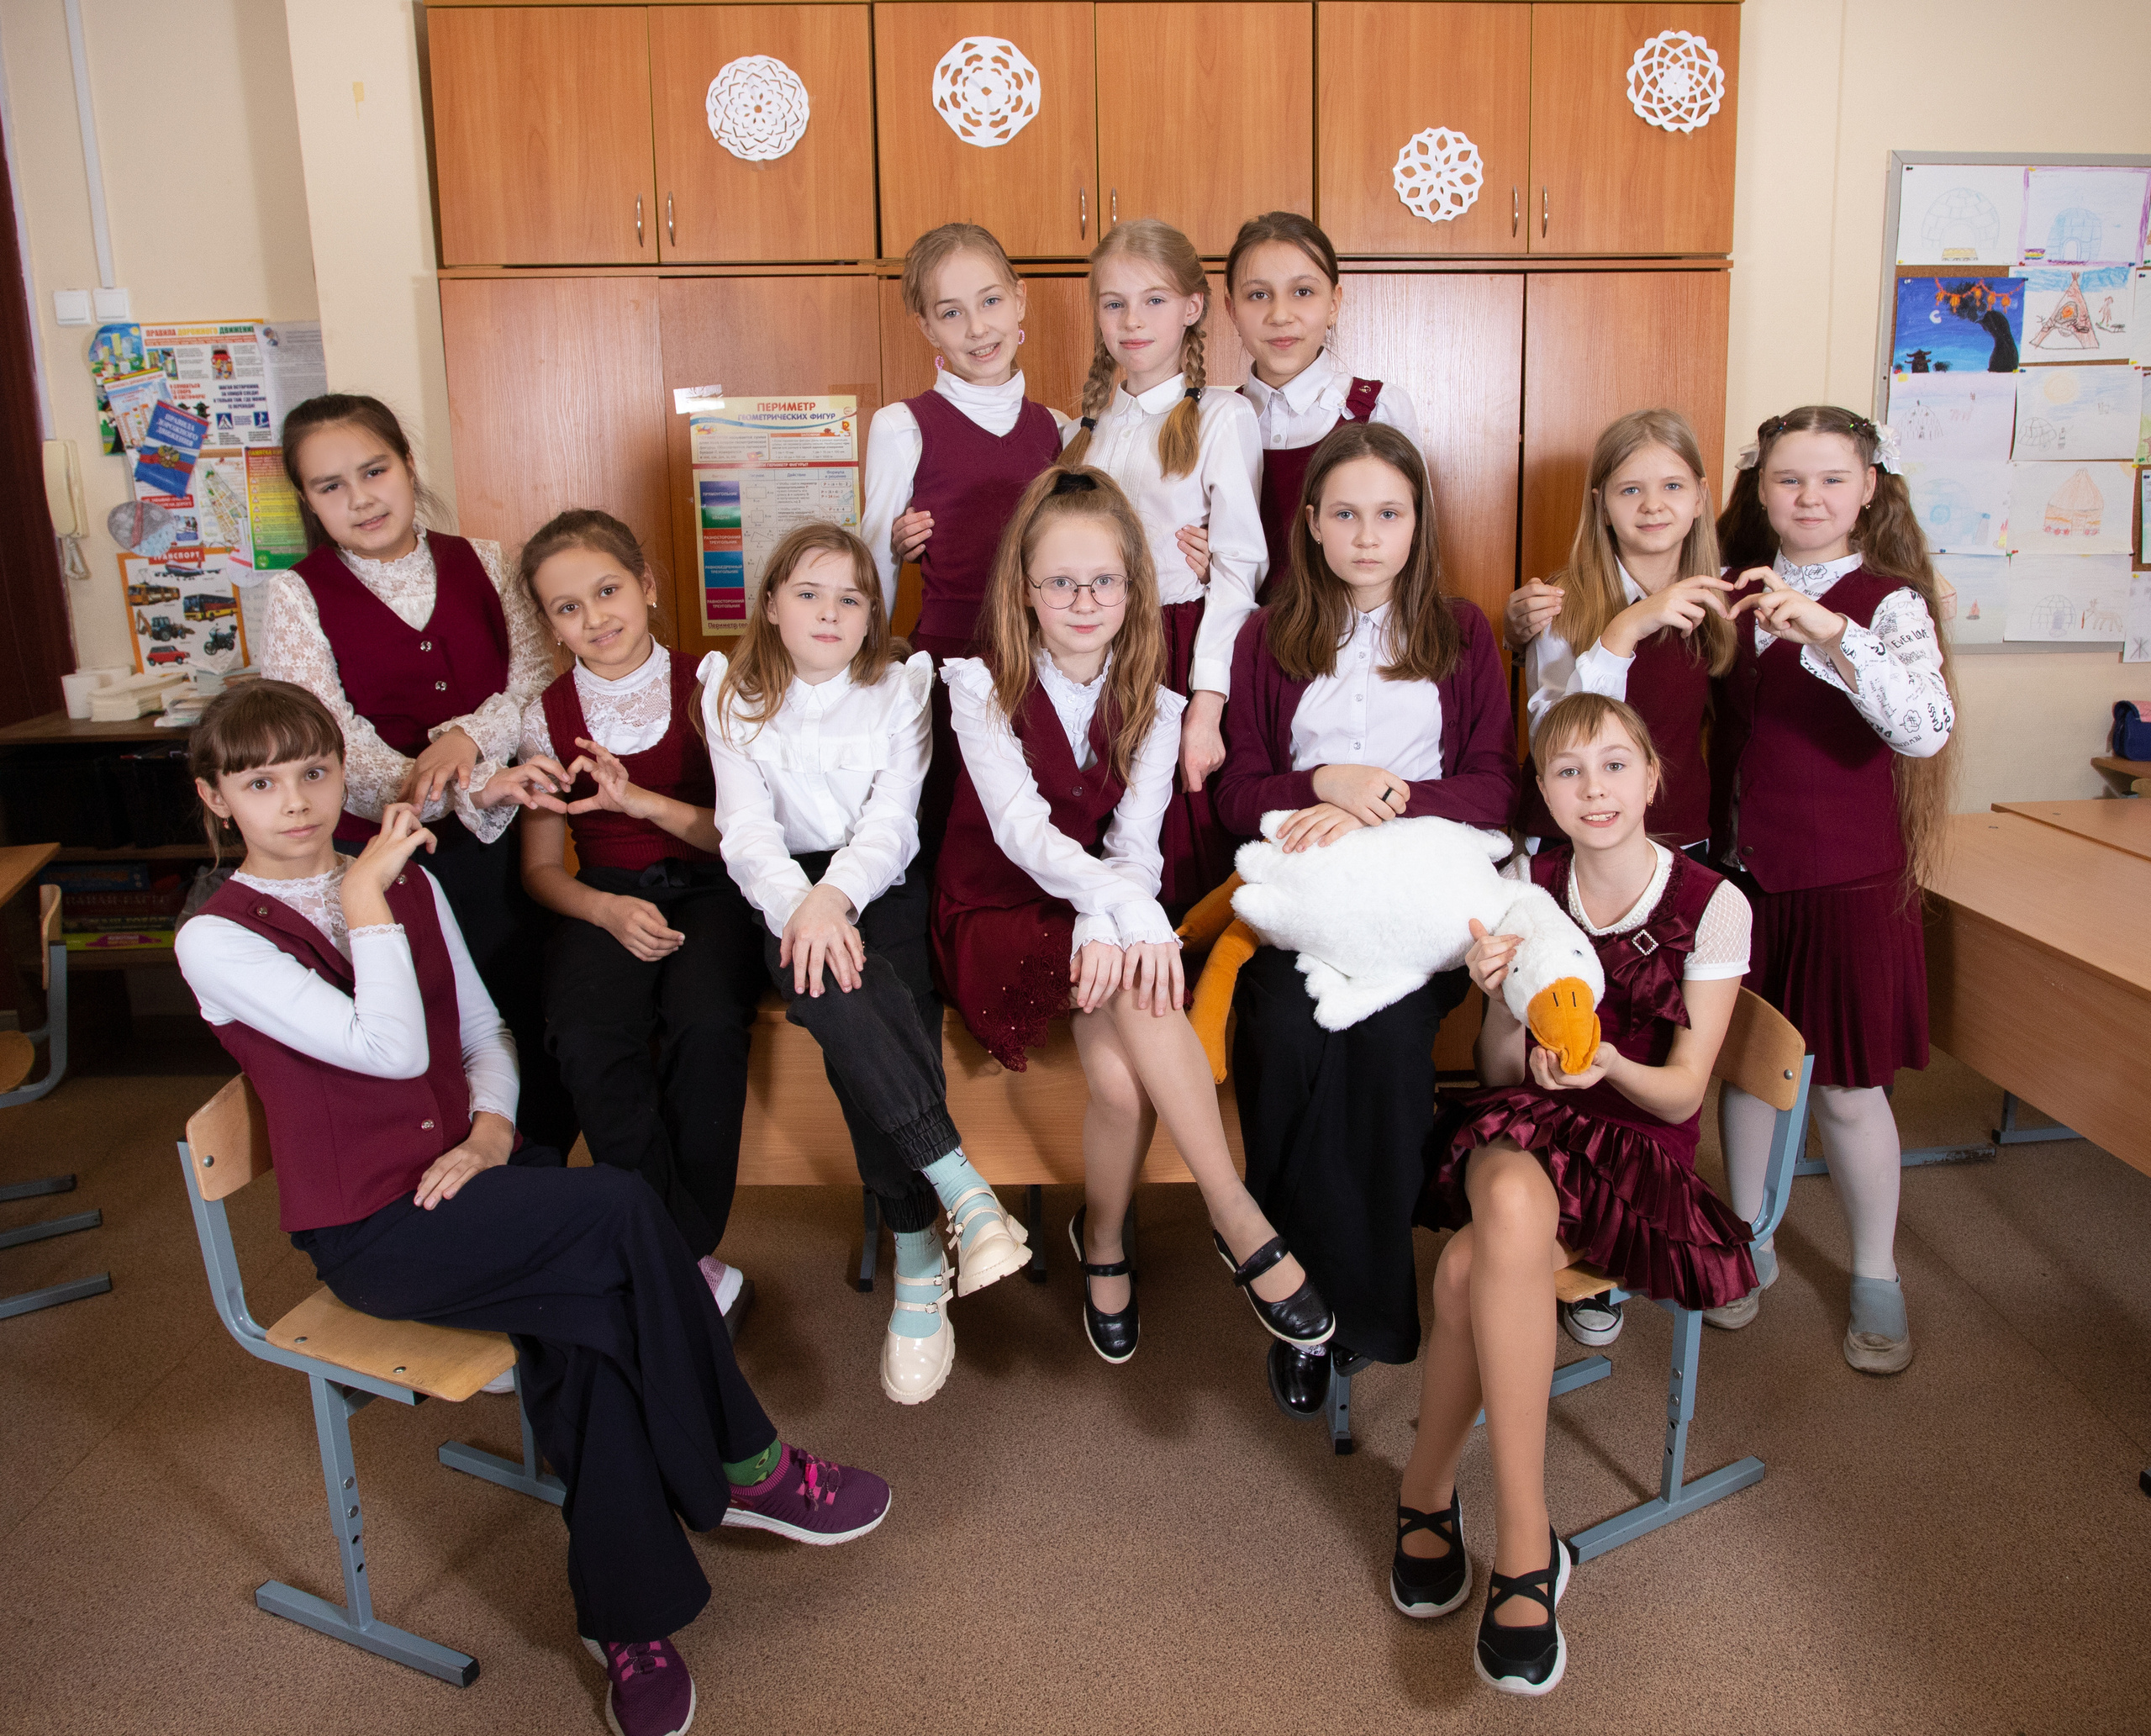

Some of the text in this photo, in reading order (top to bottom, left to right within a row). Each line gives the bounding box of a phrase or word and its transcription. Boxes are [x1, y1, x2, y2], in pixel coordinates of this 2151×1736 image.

[177, 327, 218, 336] ДОРОЖНОГО
[219, 326, 255, 335] ДВИЖЕНИ
[757, 402, 815, 412] ПЕРИМЕТР
[1891, 635, 1914, 649] EVER
[1911, 629, 1930, 640] LOVE
[1927, 702, 1944, 733] CLASSY
